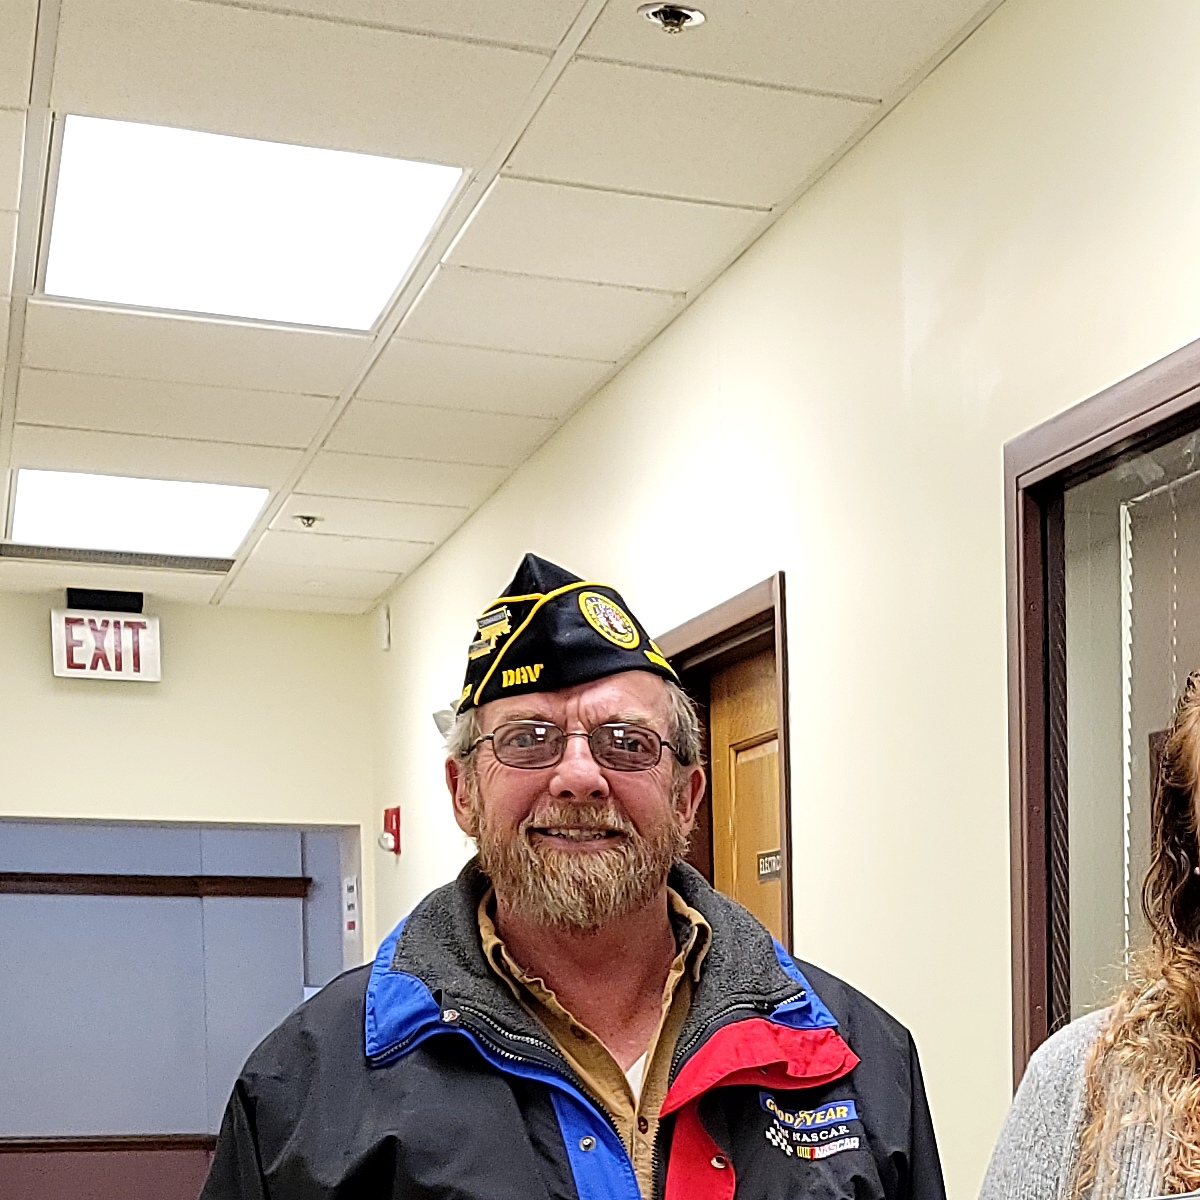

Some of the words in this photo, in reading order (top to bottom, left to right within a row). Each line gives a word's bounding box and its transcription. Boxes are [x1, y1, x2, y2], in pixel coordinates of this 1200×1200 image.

[64, 616, 147, 673] EXIT
[502, 664, 544, 688] DAV
[792, 1125, 850, 1143] NASCAR
